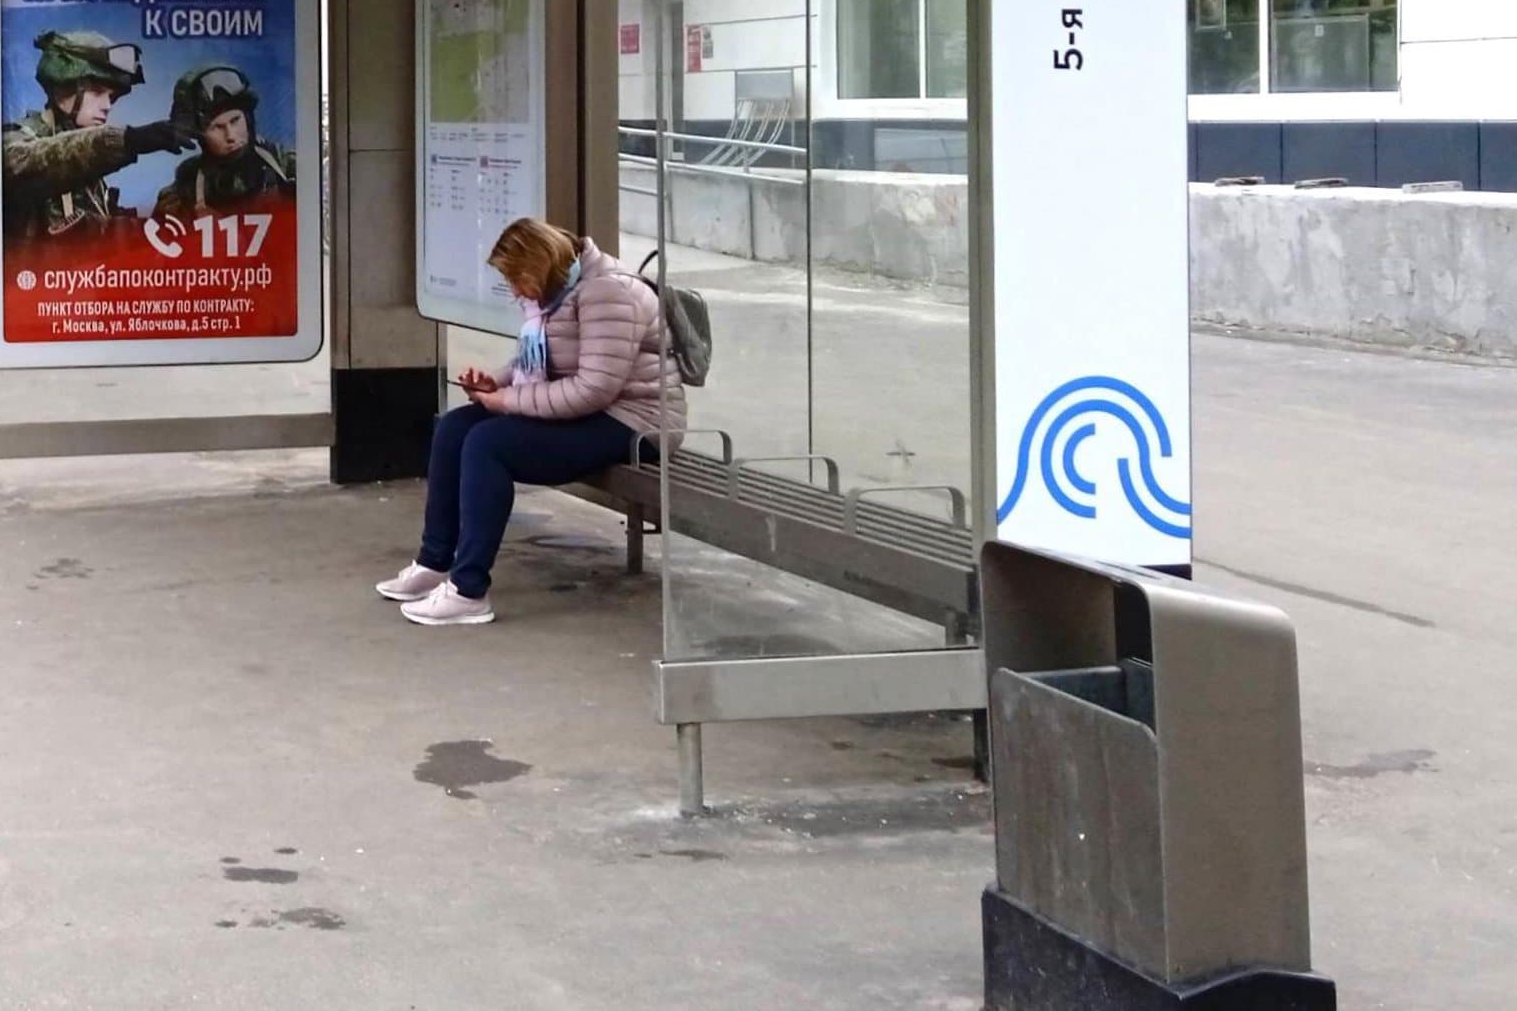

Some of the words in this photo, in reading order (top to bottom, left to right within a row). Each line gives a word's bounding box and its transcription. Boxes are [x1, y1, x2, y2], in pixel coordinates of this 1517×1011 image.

[145, 9, 163, 36] К
[171, 9, 263, 37] СВОИМ
[1053, 9, 1084, 71] 5-я
[193, 213, 273, 258] 117
[44, 263, 272, 295] службапоконтракту.рф
[37, 301, 72, 317] ПУНКТ
[74, 300, 115, 316] ОТБОРА
[116, 301, 131, 315] НА
[131, 299, 175, 315] СЛУЖБУ
[176, 299, 191, 314] ПО
[193, 298, 255, 313] КОНТРАКТУ:
[52, 321, 61, 334] г.
[62, 318, 109, 334] Москва,
[109, 320, 127, 335] ул.
[128, 317, 190, 332] Яблочкова,
[210, 318, 233, 332] стр.
[234, 315, 242, 329] 1
